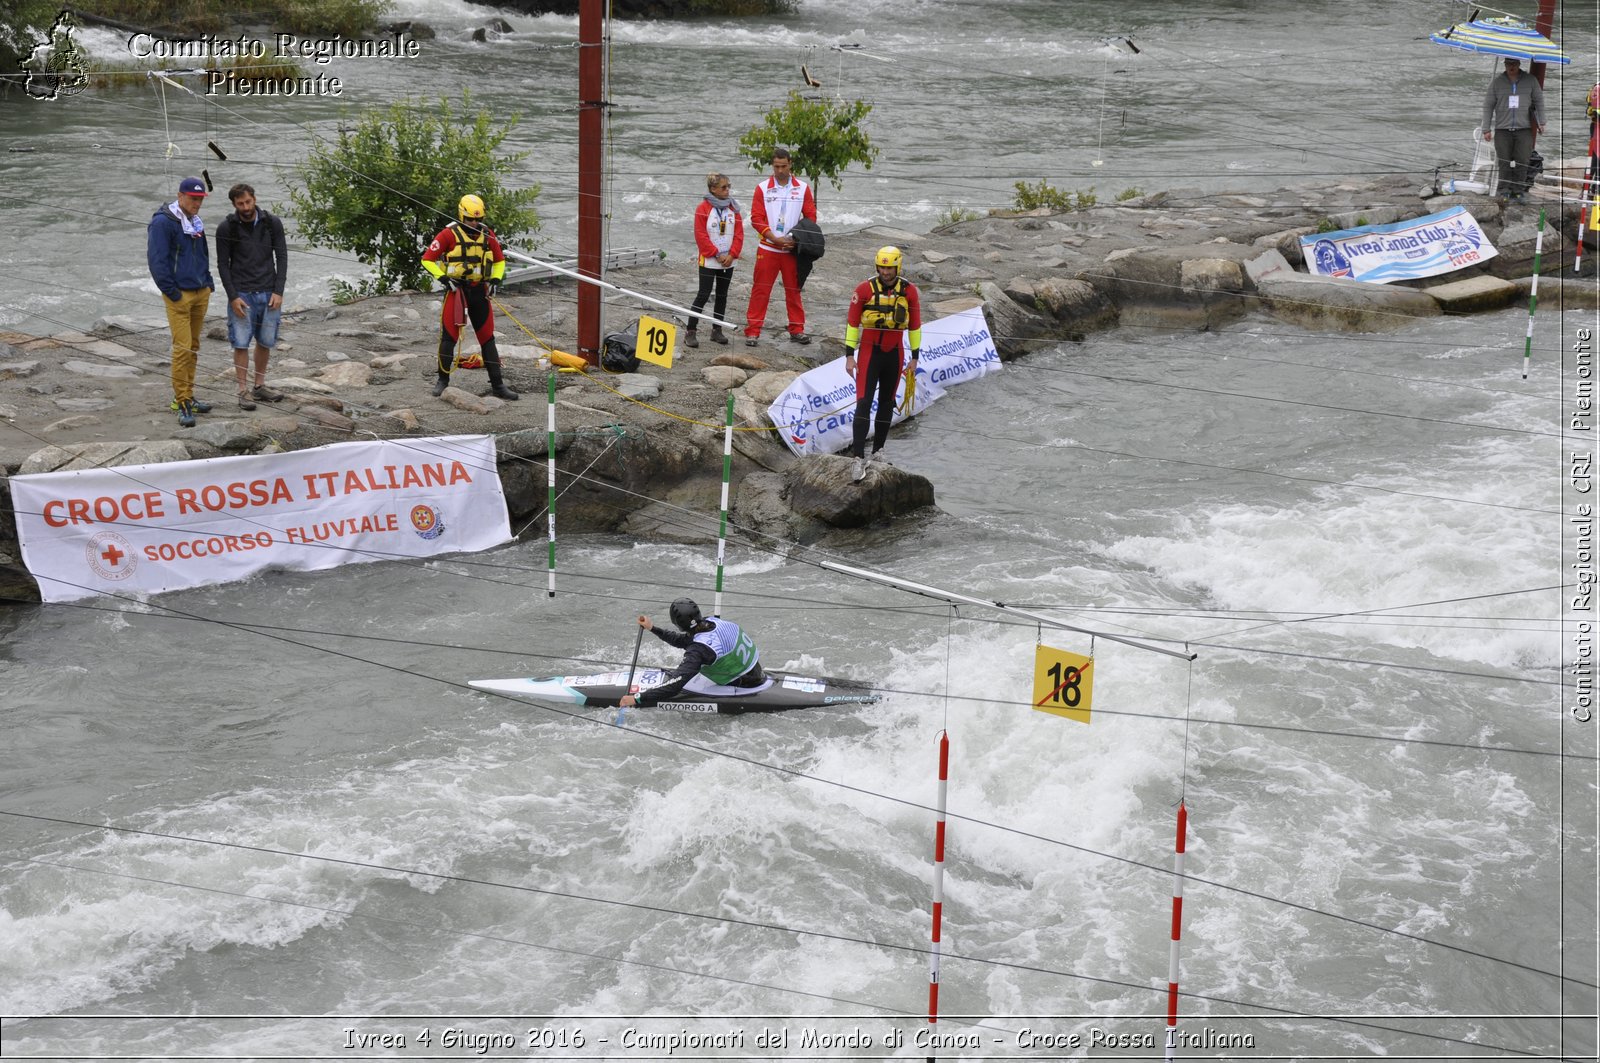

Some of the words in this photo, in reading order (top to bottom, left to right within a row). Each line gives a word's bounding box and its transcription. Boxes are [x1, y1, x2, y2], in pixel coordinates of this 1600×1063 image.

[1343, 241, 1383, 258] Ivrea
[1379, 236, 1420, 251] Canoa
[1416, 225, 1448, 245] Club
[646, 326, 668, 356] 19
[931, 363, 966, 384] Canoa
[42, 491, 165, 528] CROCE
[175, 477, 294, 515] ROSSA
[303, 460, 473, 500] ITALIANA
[143, 531, 273, 561] SOCCORSO
[286, 513, 399, 544] FLUVIALE
[1047, 661, 1082, 708] 18
